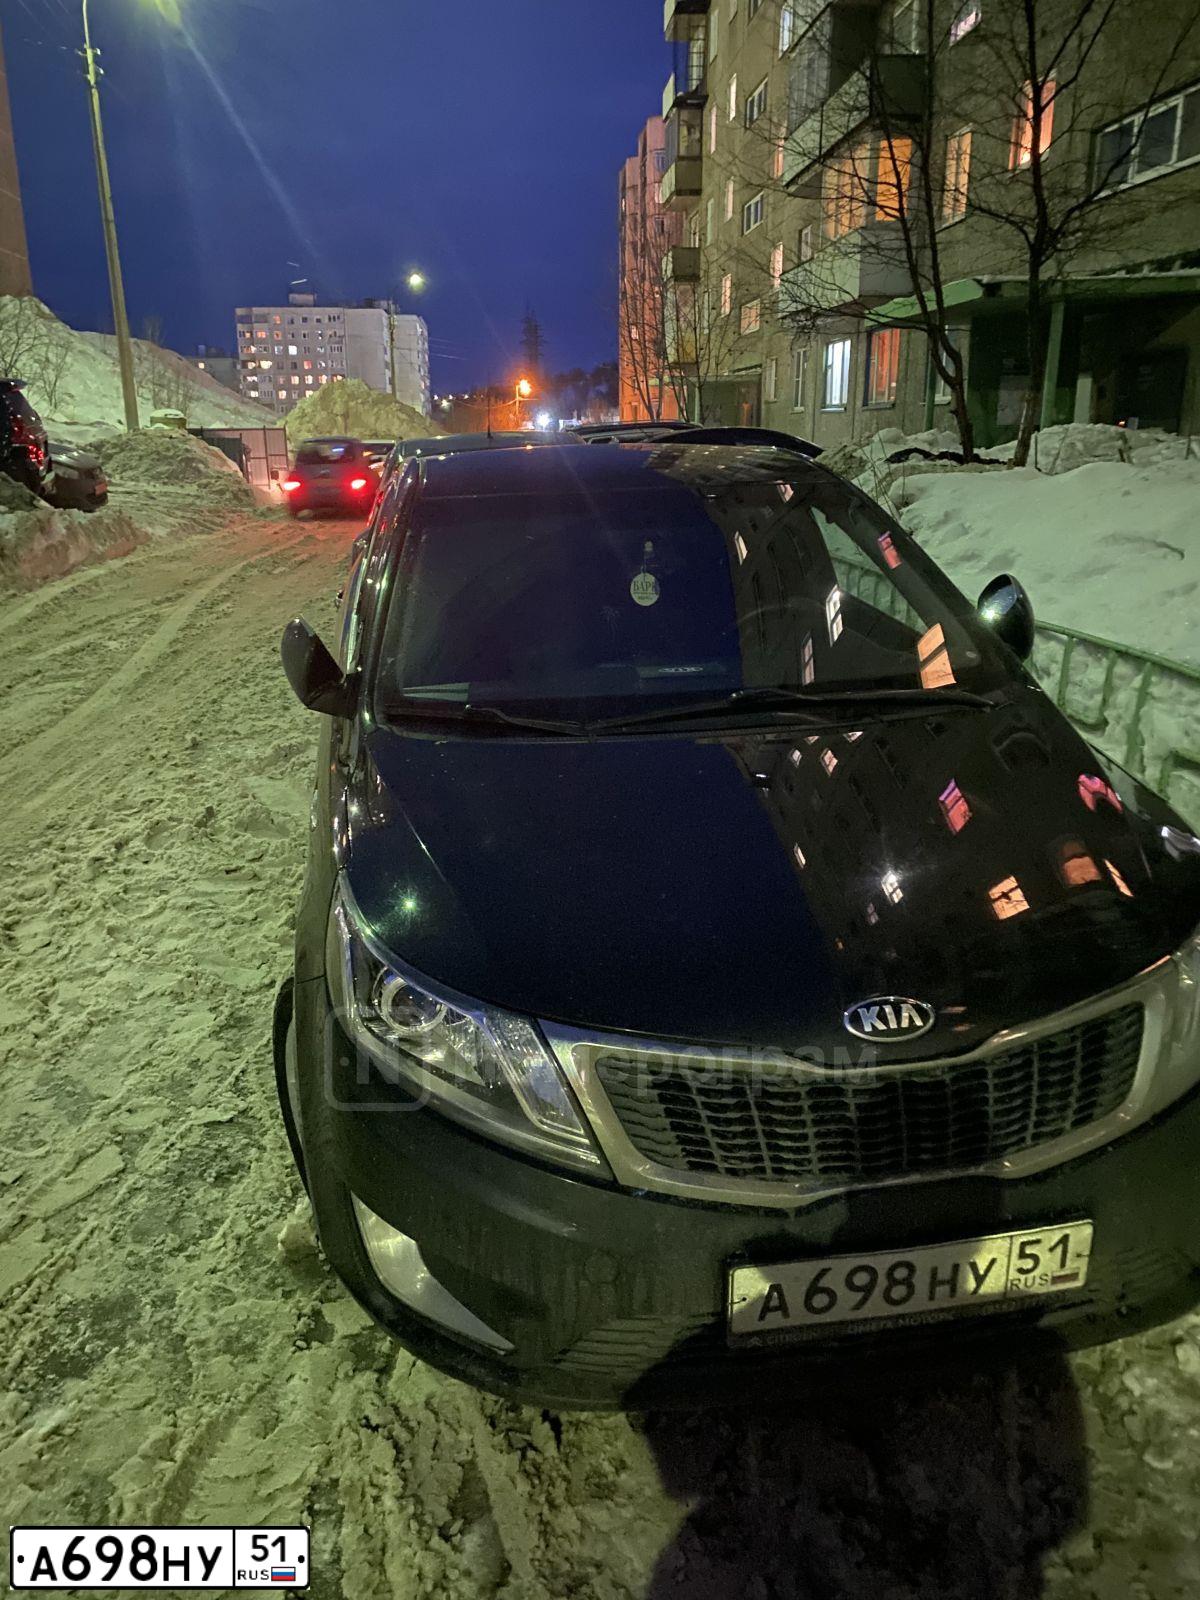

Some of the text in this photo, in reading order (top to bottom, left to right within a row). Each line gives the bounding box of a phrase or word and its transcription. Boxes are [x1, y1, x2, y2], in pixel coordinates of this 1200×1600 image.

[857, 1003, 924, 1032] KIA
[1016, 1233, 1070, 1275] 51
[757, 1257, 998, 1322] А698НУ
[1009, 1273, 1049, 1291] RUS
